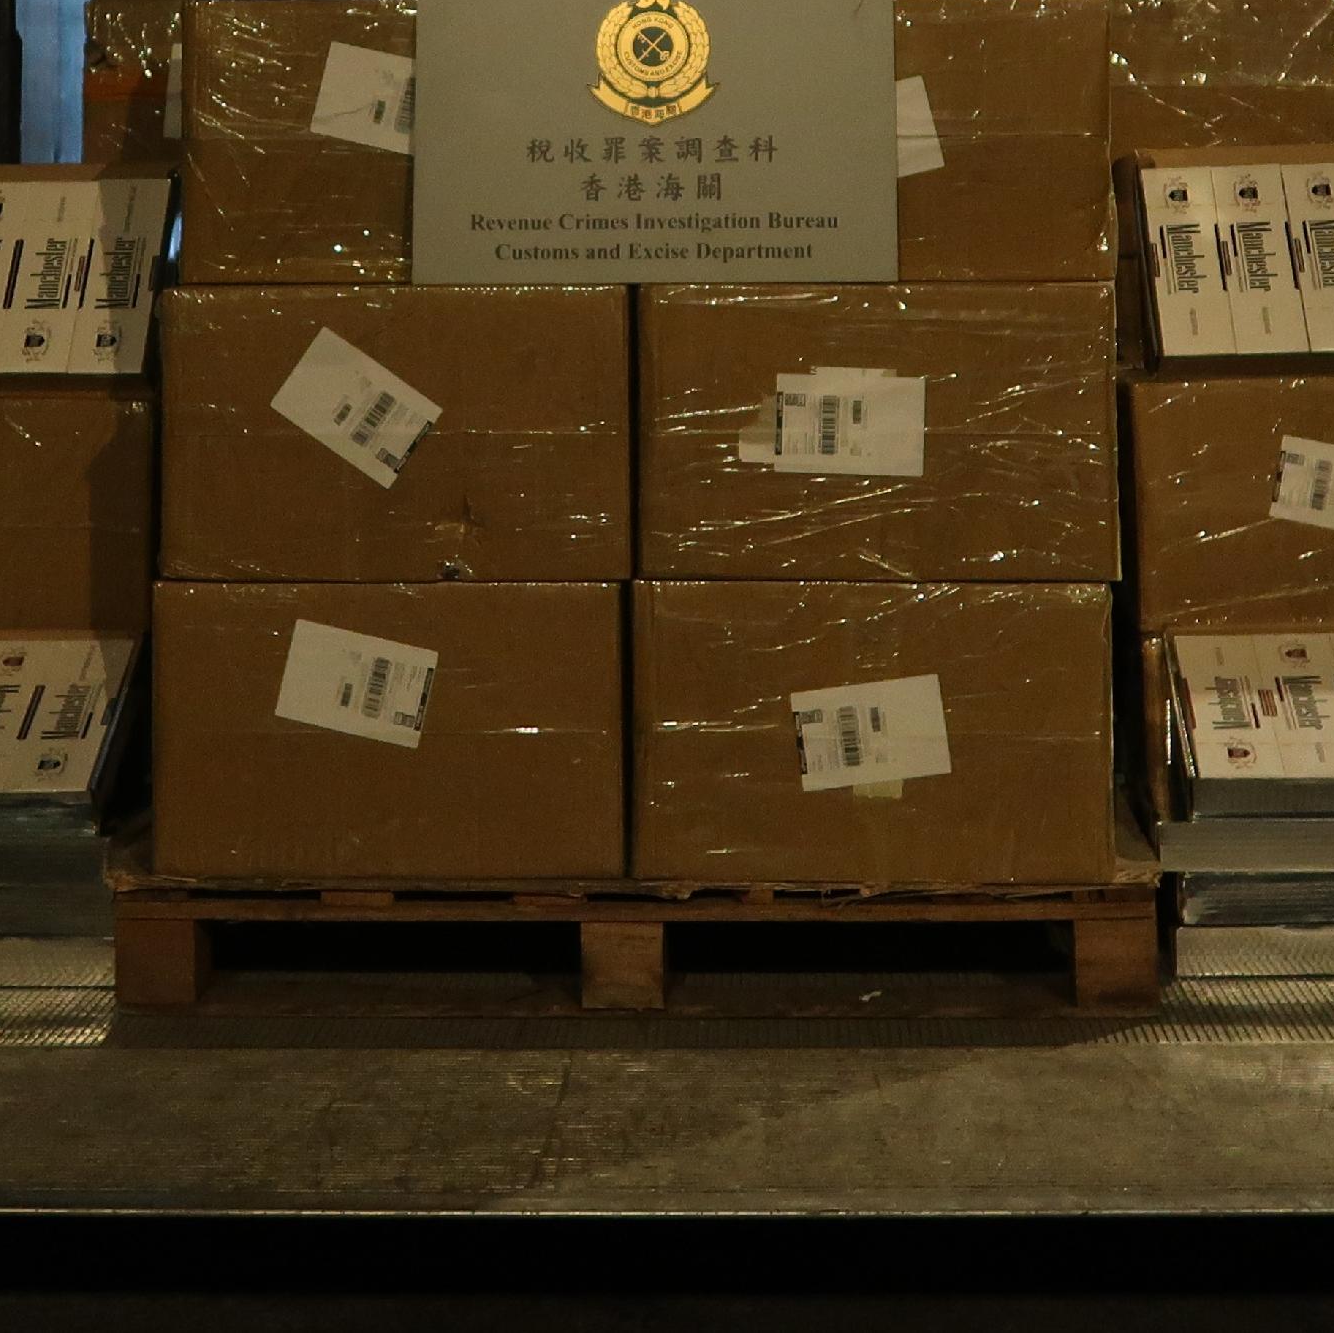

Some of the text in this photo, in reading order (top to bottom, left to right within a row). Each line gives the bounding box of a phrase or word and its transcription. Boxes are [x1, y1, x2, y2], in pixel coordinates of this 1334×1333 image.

[580, 173, 722, 202] 香港海關
[471, 213, 838, 234] Revenue Crimes Investigation Bureau
[495, 243, 813, 264] Customs and Excise Department
[1165, 222, 1207, 294] Manchester
[1236, 221, 1278, 292] Manchester
[25, 237, 68, 309] Manchester
[94, 236, 137, 310] Manchester
